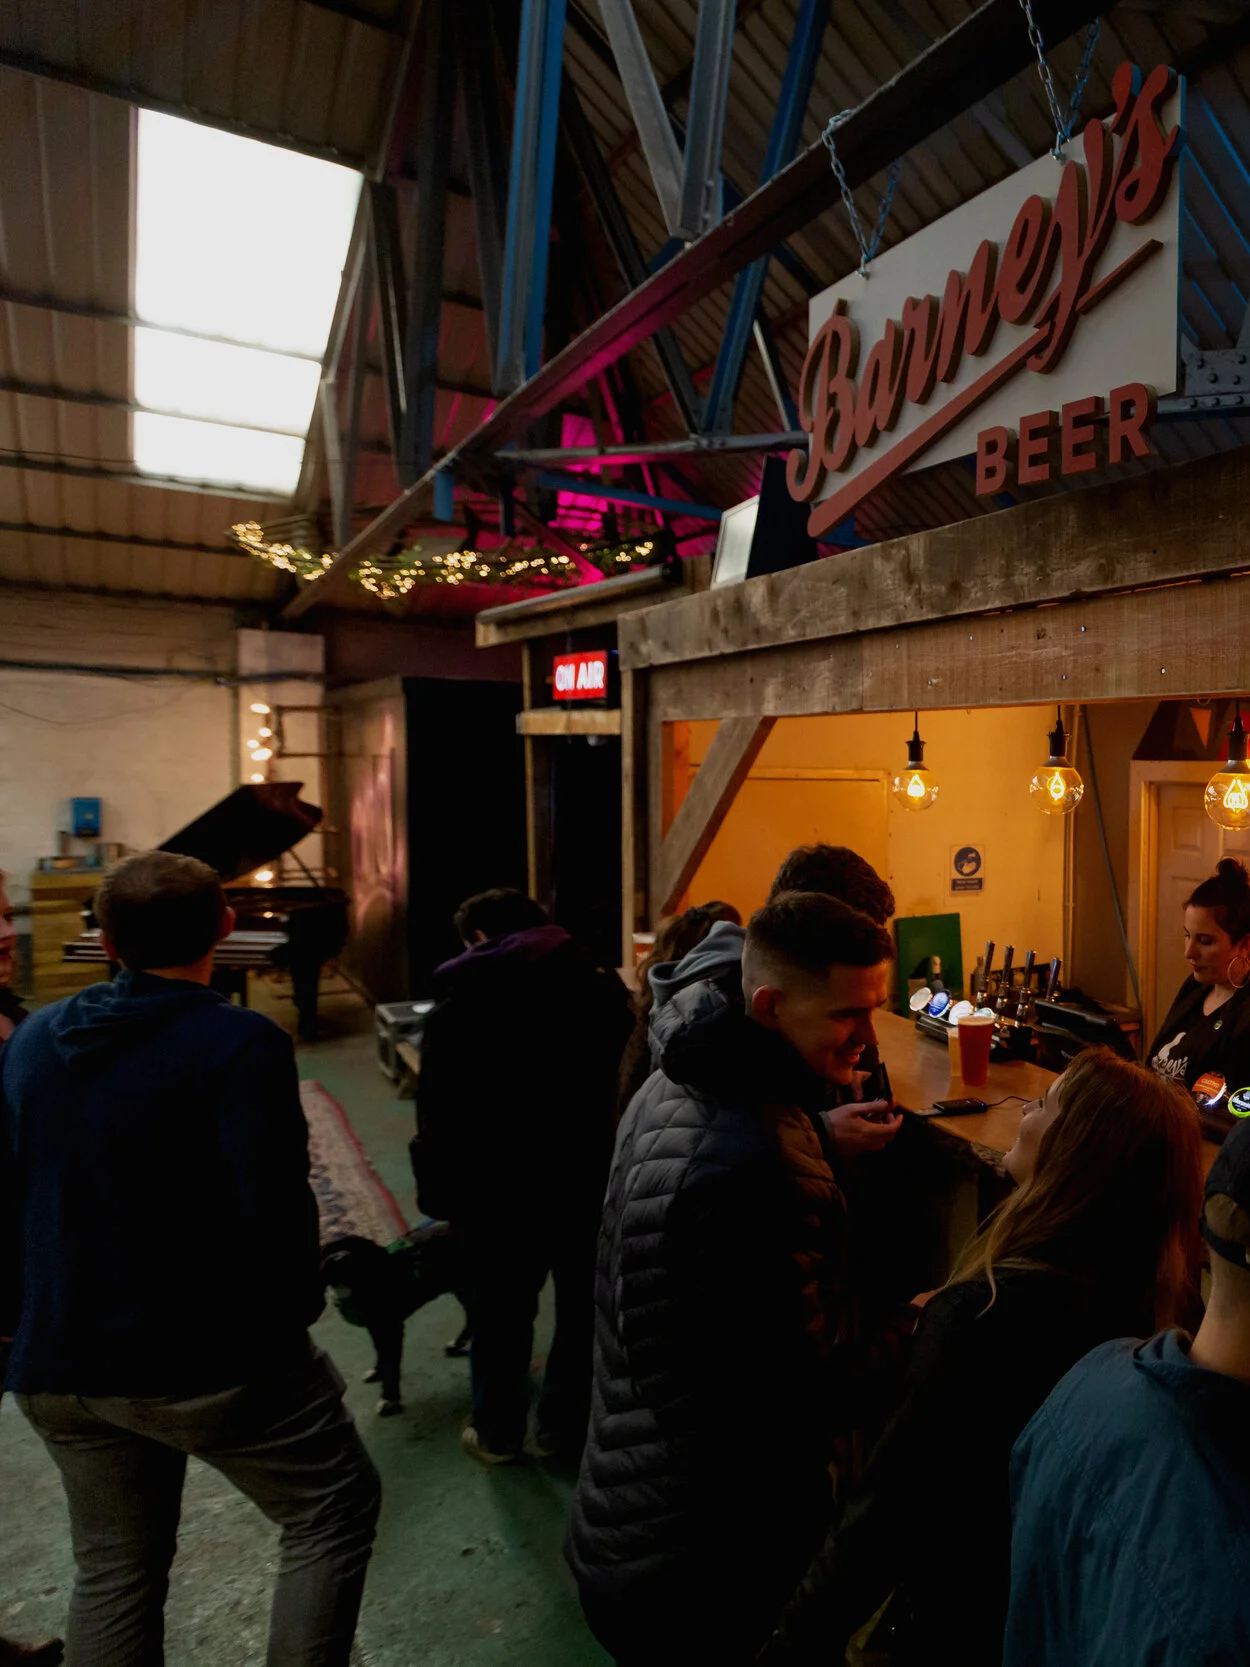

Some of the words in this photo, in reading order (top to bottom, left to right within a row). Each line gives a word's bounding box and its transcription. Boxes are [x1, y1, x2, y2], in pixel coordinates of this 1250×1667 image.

[785, 61, 1185, 502] Barney's
[975, 382, 1158, 496] BEER
[555, 663, 576, 692] ON
[576, 660, 605, 690] AIR
